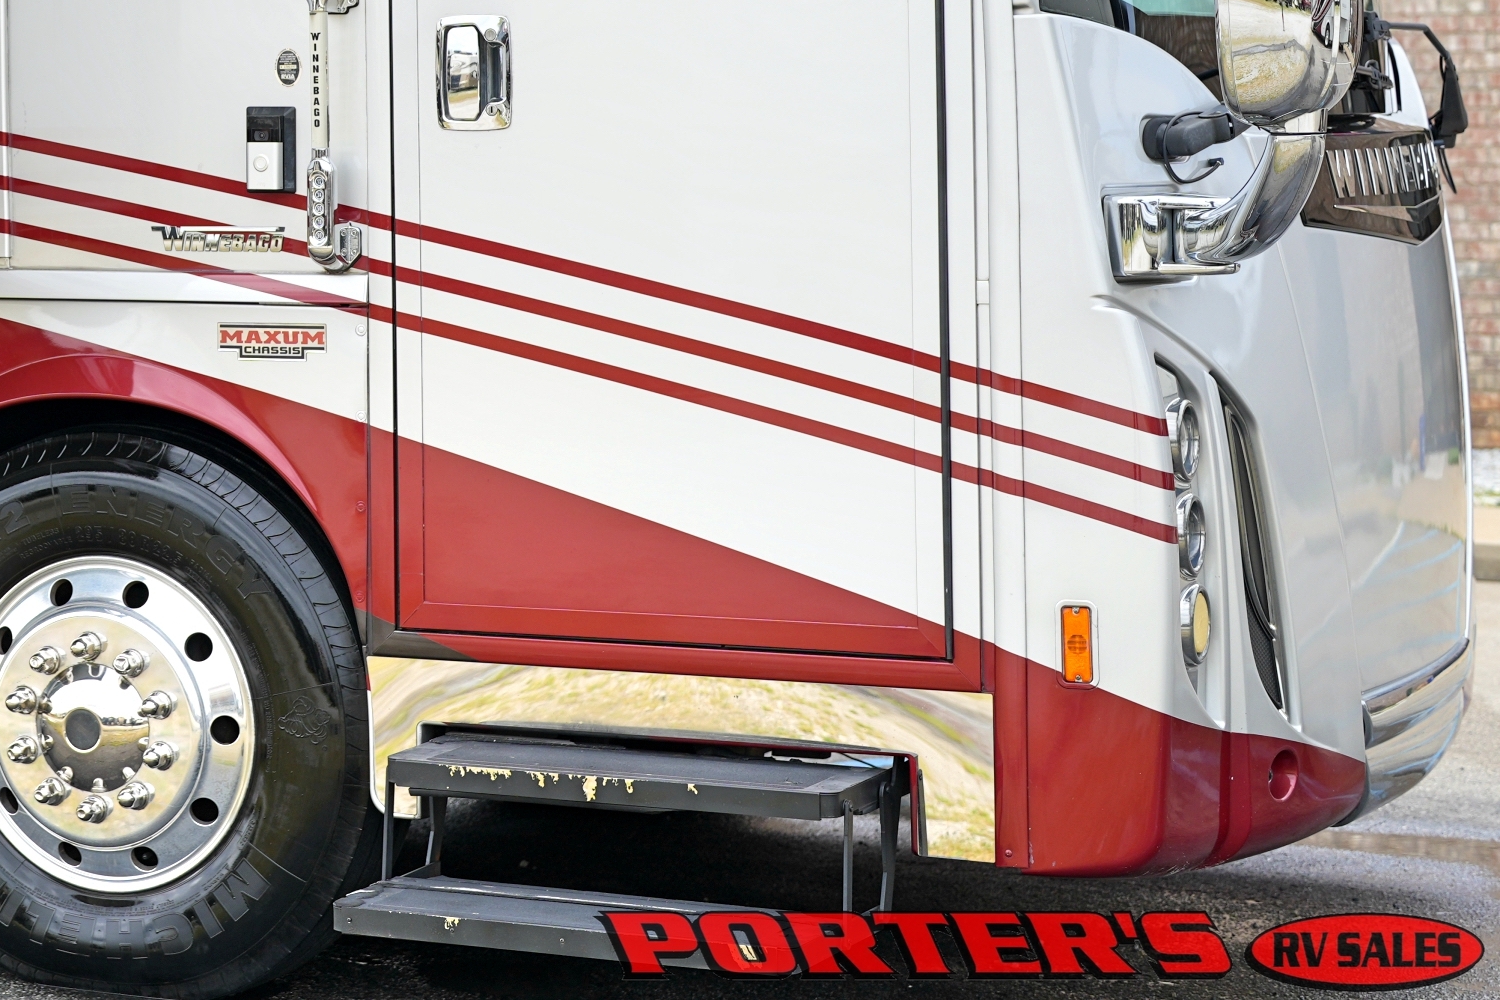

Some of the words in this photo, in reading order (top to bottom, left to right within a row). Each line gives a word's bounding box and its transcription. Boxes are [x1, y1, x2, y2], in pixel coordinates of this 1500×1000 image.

[310, 32, 321, 127] WINNEBAGO
[219, 330, 325, 345] MAXUM
[243, 346, 301, 355] CHASSIS
[58, 483, 272, 600] ENERGY
